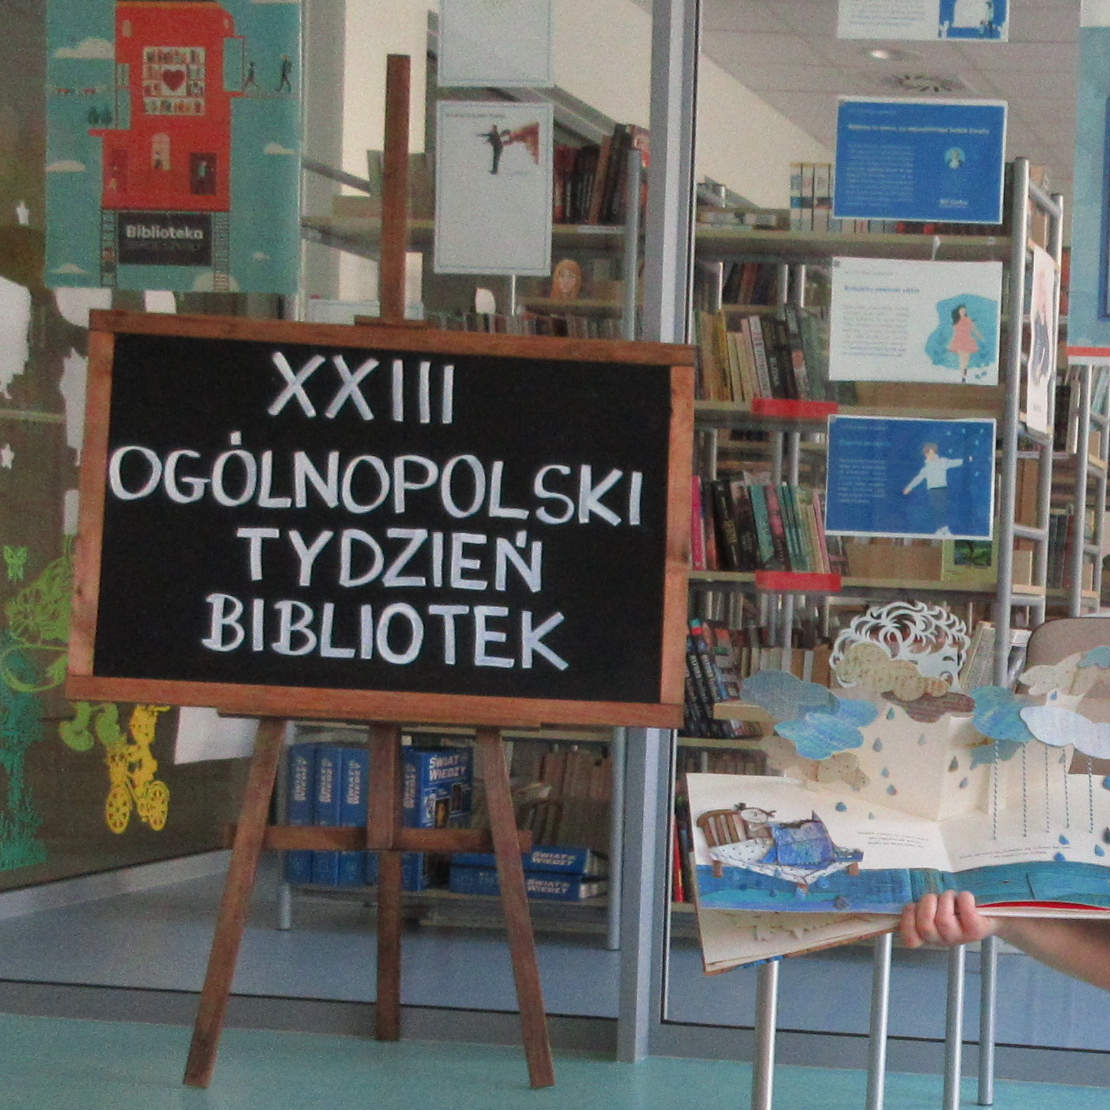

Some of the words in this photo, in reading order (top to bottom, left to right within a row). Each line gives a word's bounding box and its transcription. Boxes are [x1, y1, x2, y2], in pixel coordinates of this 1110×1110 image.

[126, 224, 204, 240] Biblioteka
[266, 351, 456, 425] XXIII
[108, 431, 643, 527] OGÓLNOPOLSKI
[235, 527, 543, 593] TYDZIEŃ
[201, 593, 570, 671] BIBLIOTEK
